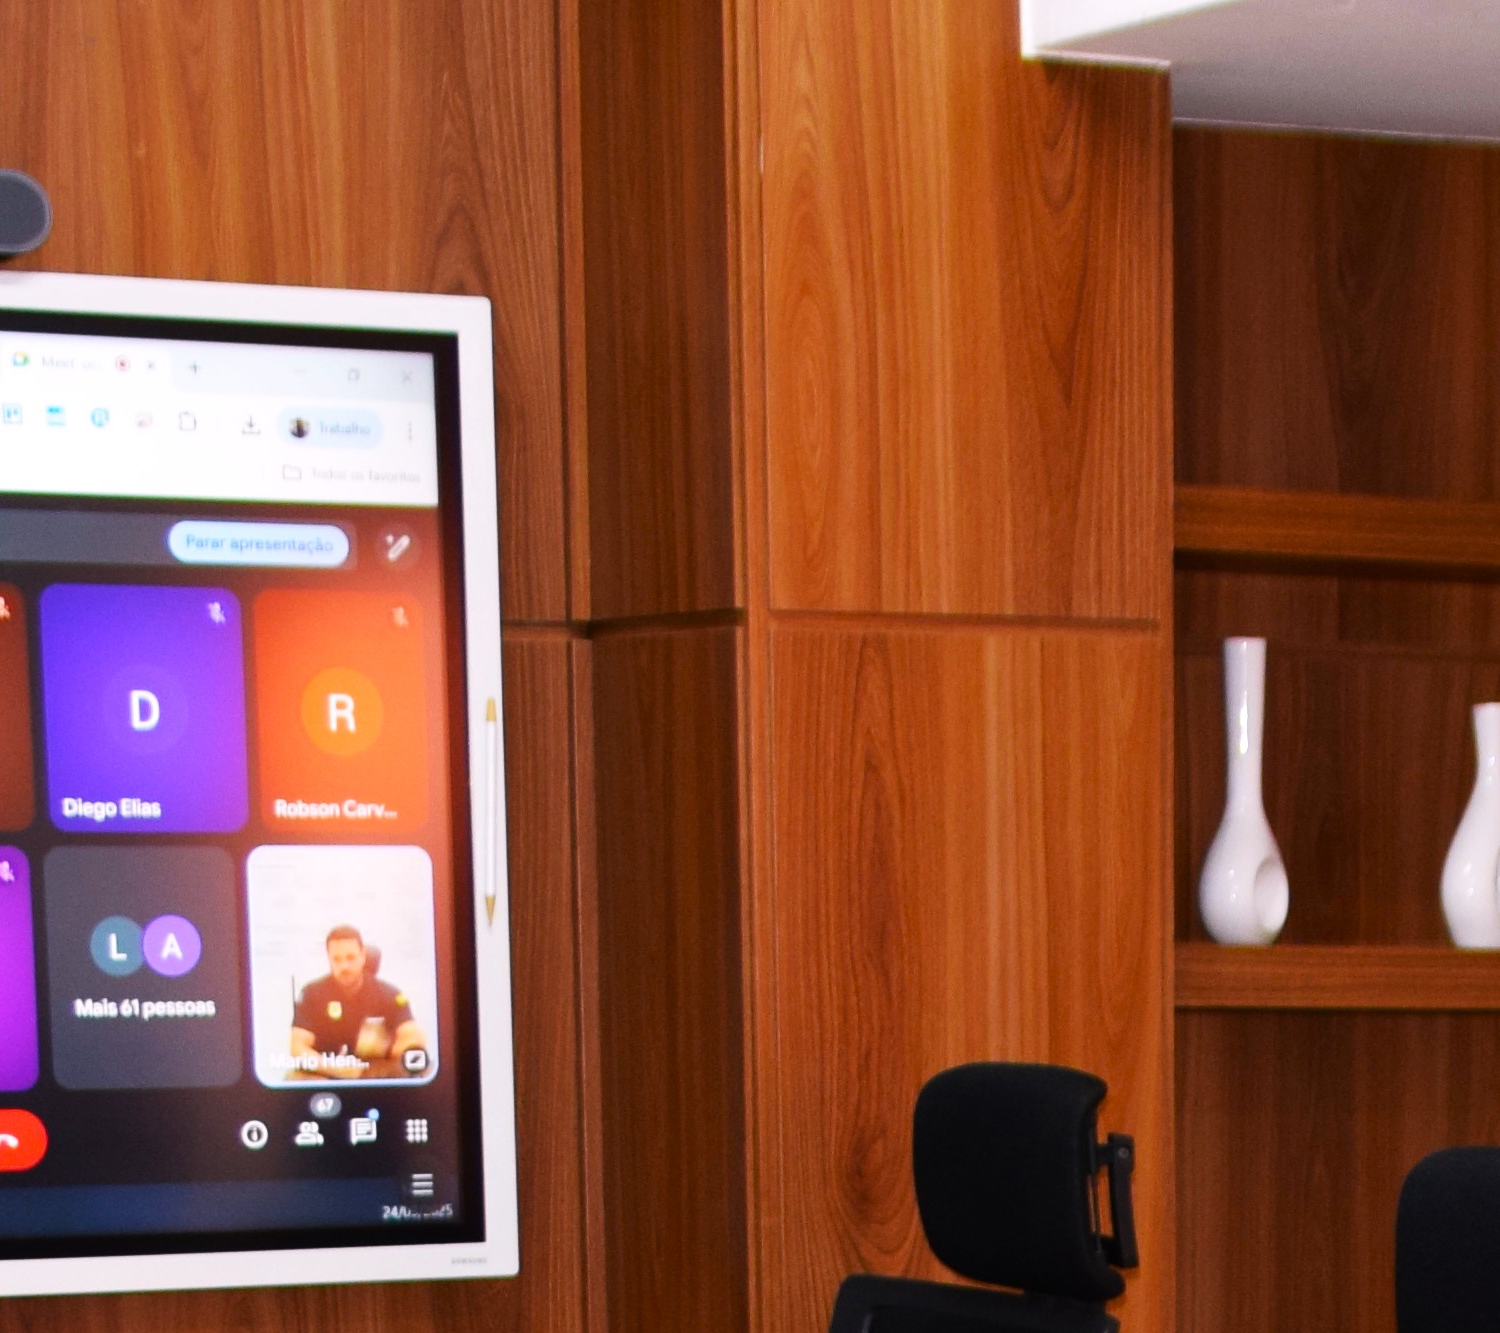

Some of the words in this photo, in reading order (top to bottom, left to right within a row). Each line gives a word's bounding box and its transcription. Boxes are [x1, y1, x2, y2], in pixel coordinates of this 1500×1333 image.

[184, 532, 224, 550] Parar
[228, 534, 335, 556] apresentação
[129, 689, 160, 731] D
[327, 692, 357, 732] R
[62, 796, 116, 821] Diego
[119, 797, 161, 817] Elias
[273, 798, 339, 818] Robson
[107, 932, 128, 961] L
[159, 932, 183, 960] A
[74, 998, 117, 1018] Mais
[120, 997, 140, 1017] 61
[142, 1000, 216, 1022] pessoas
